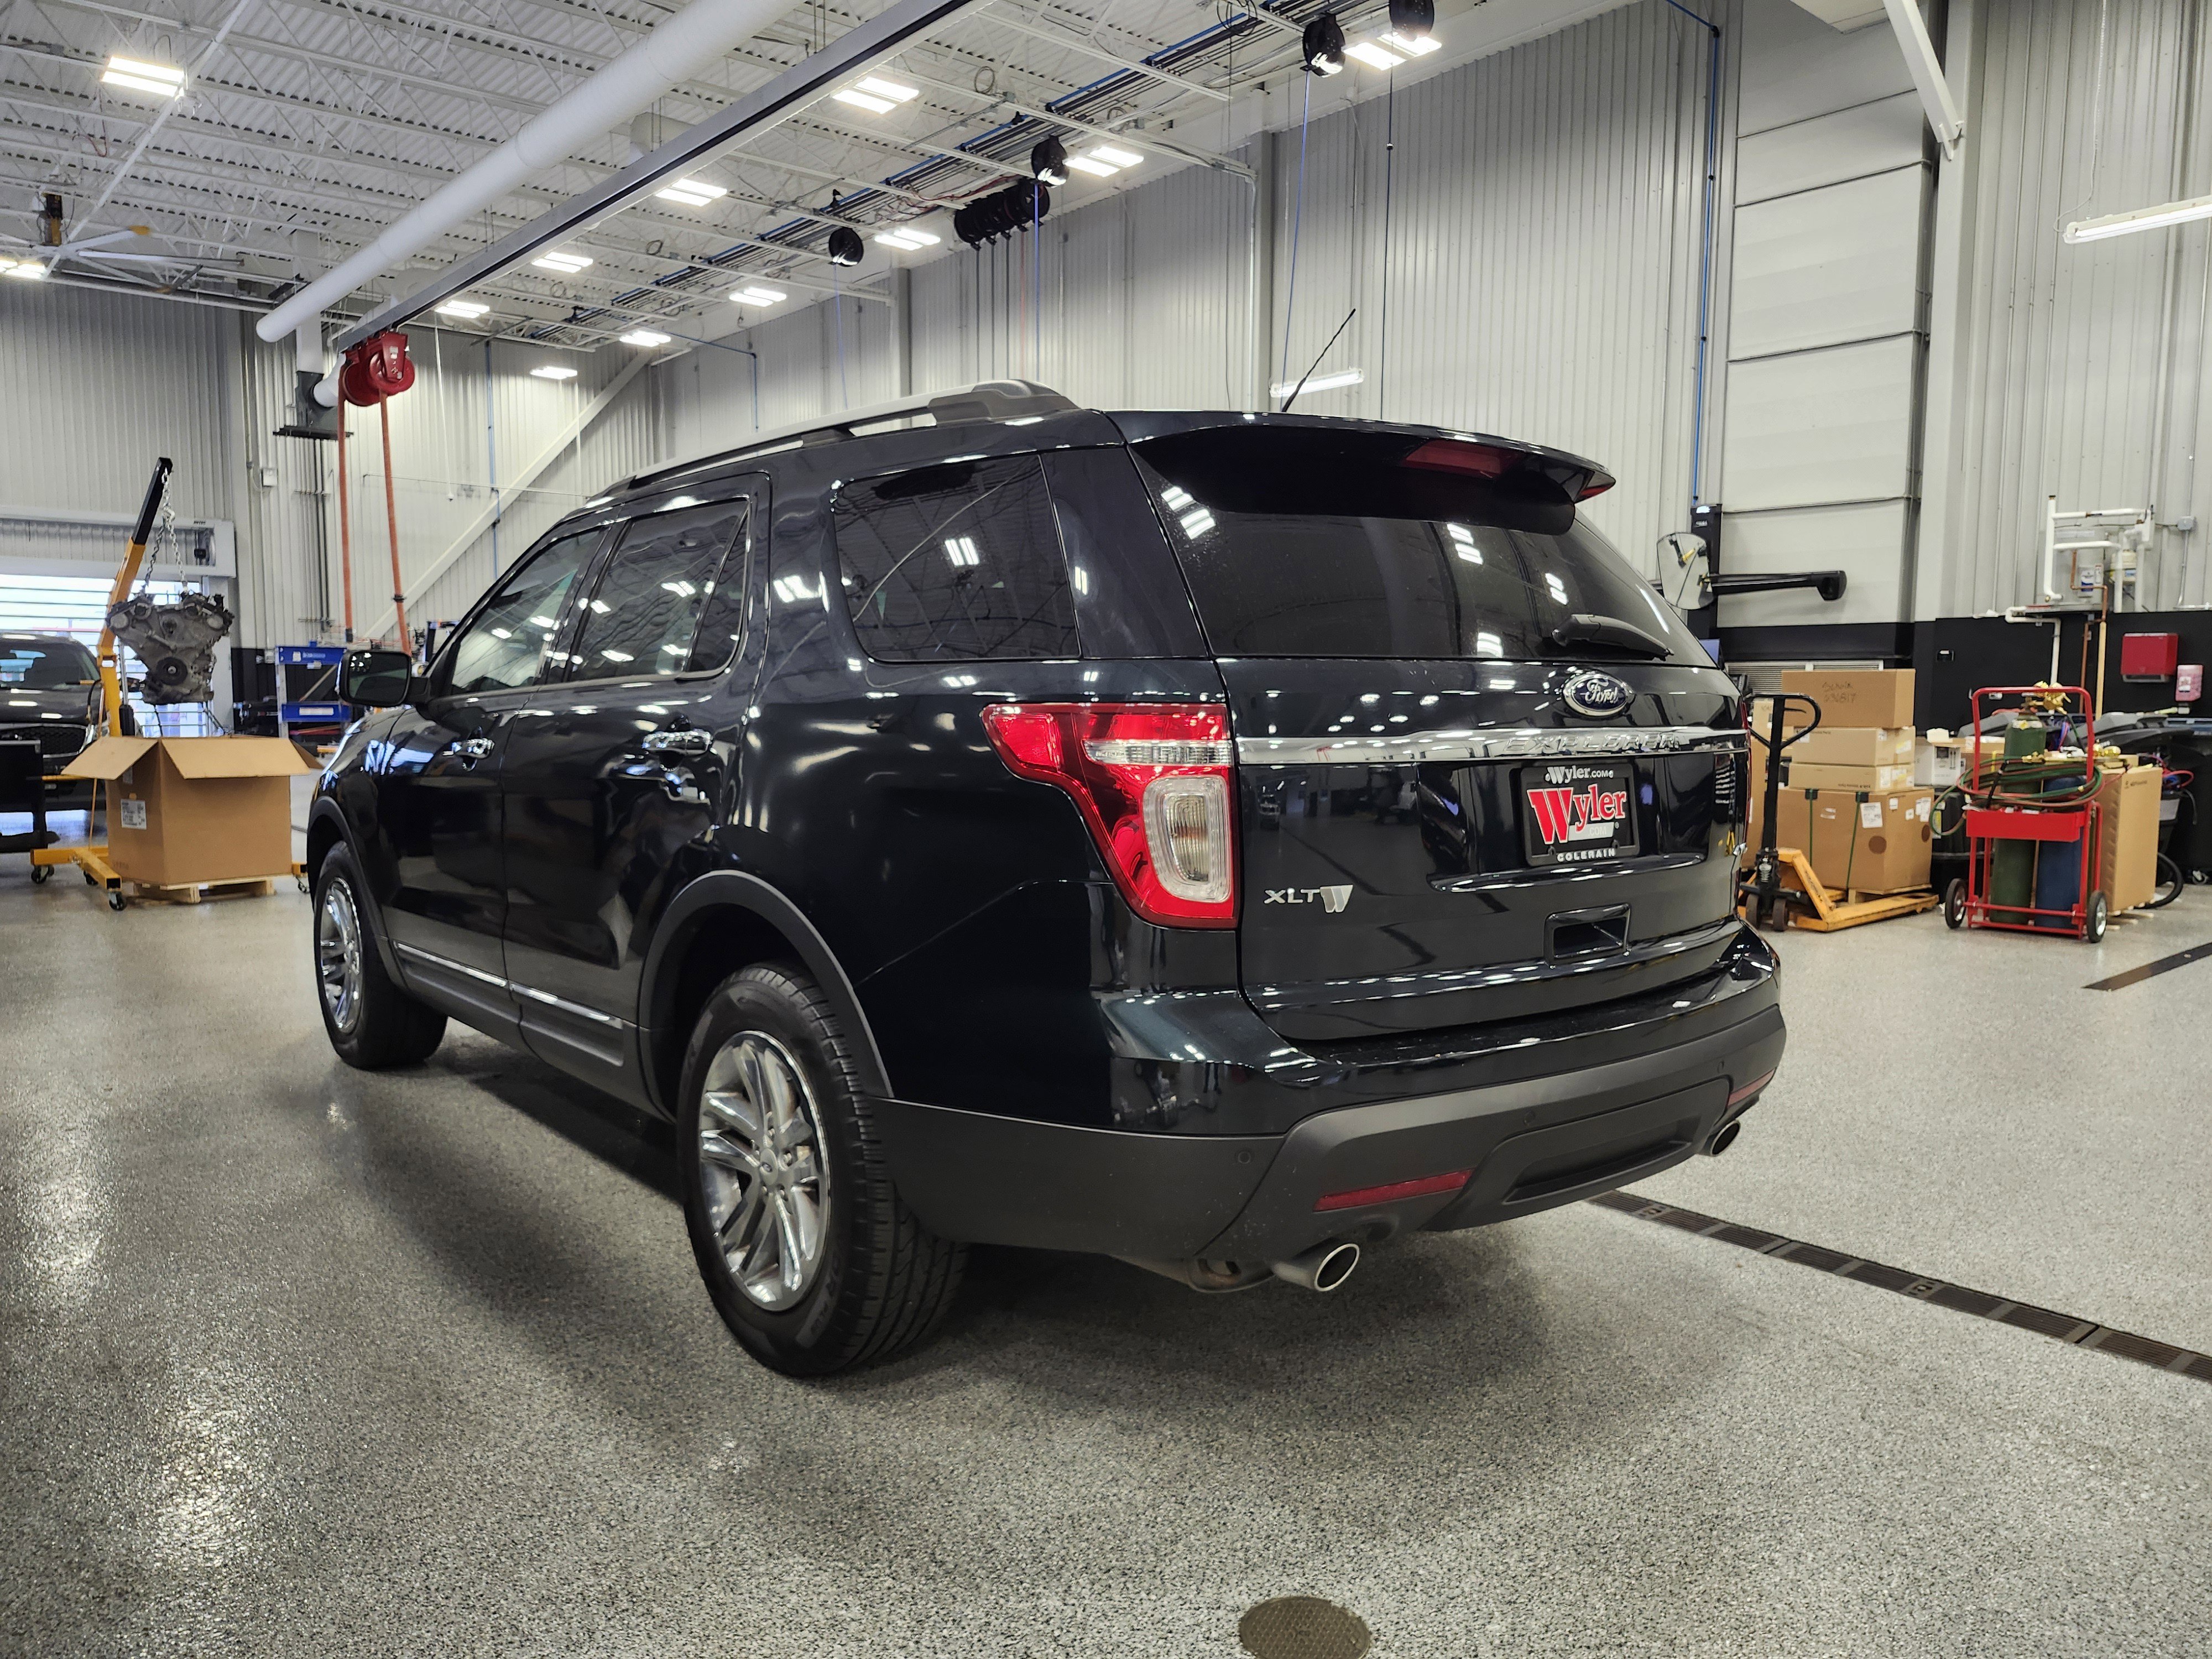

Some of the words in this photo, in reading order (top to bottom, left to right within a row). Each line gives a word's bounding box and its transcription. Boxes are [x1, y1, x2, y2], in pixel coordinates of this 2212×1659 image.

[1580, 679, 1618, 704] Ford
[1504, 733, 1679, 753] EXPLORER
[1527, 784, 1627, 844] Wyler
[1557, 848, 1616, 862] COLERAIN
[1264, 888, 1320, 904] XLT
